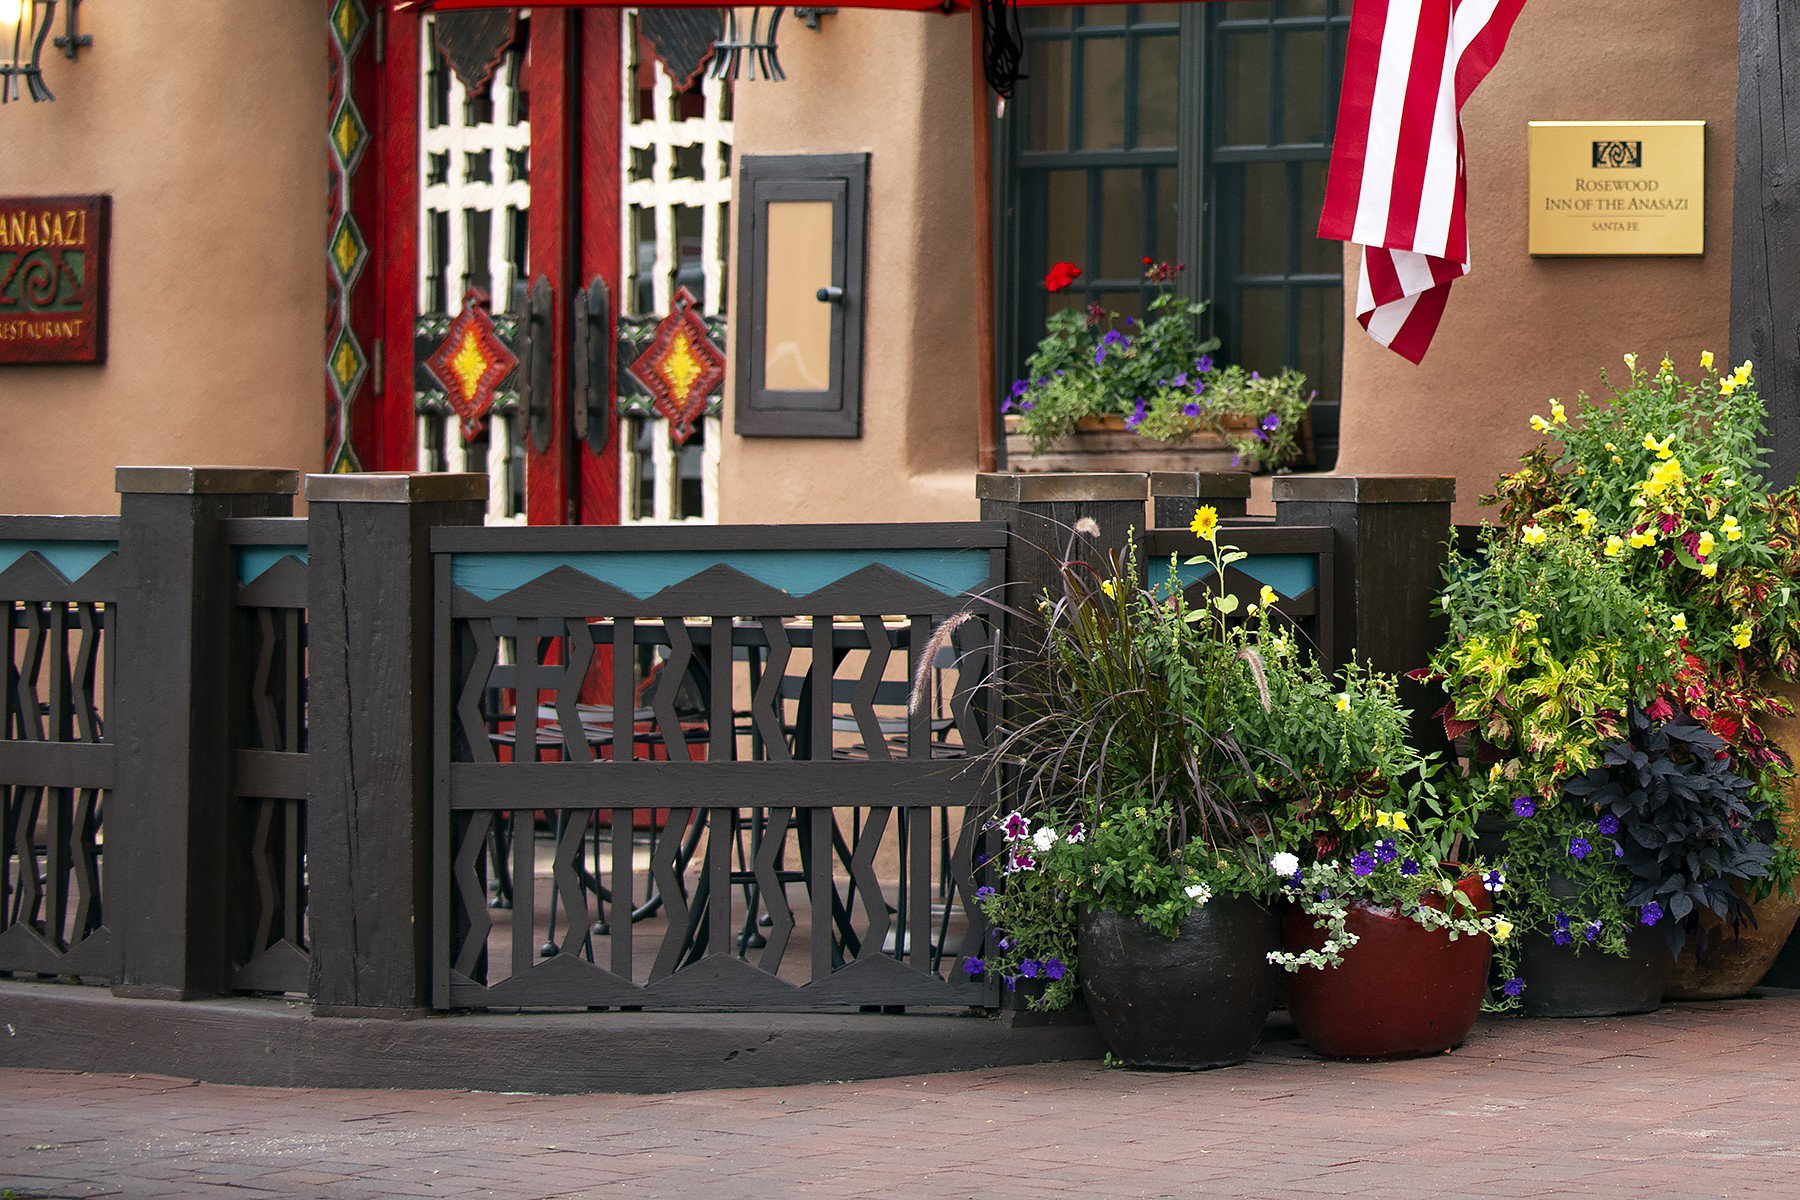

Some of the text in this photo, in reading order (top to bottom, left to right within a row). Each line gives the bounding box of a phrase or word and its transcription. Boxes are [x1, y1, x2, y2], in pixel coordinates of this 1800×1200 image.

[1575, 178, 1660, 192] ROSEWOOD
[1545, 197, 1689, 211] INN OF THE ANASAZI
[1591, 222, 1640, 232] SANTA FE
